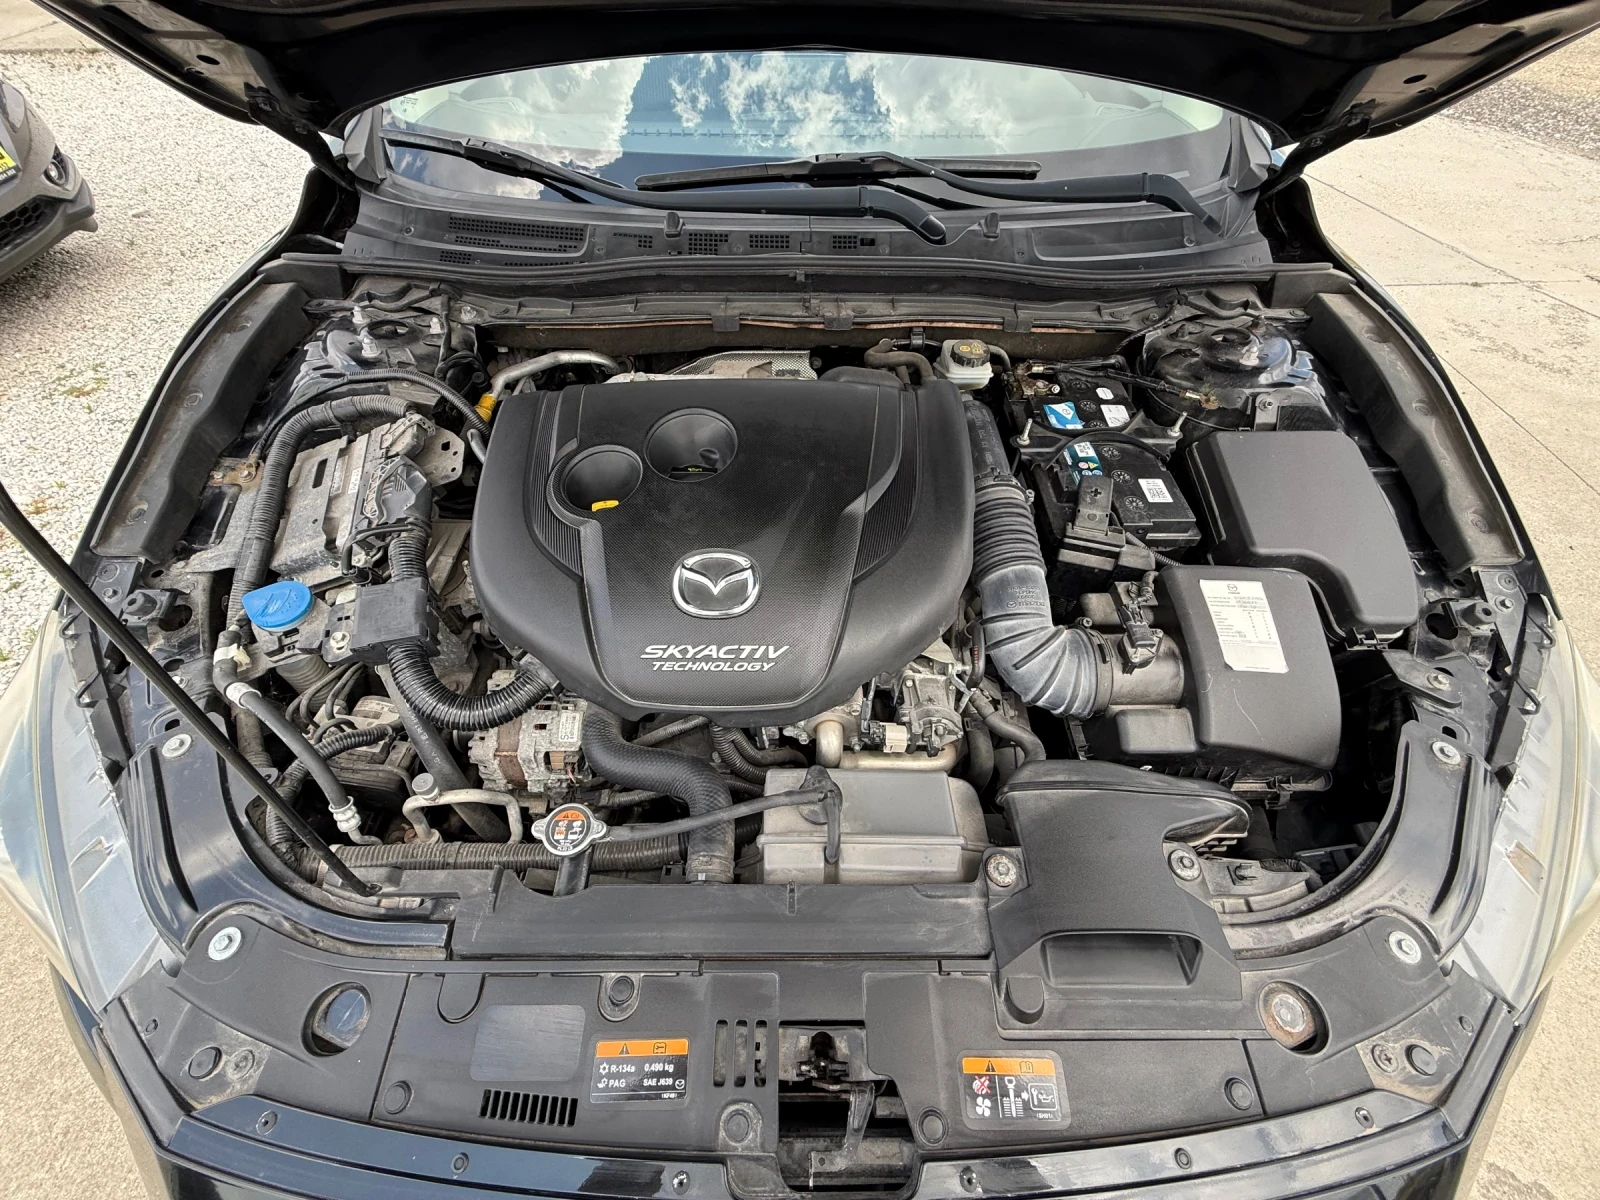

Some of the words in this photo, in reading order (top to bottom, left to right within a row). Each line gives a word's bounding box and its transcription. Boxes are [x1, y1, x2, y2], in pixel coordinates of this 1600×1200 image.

[640, 645, 790, 659] SKYACTIV
[652, 661, 776, 672] TECHNOLOGY
[610, 1064, 635, 1073] R-134a
[664, 1062, 674, 1073] kg
[608, 1078, 626, 1088] PAG
[643, 1078, 657, 1086] SAE
[658, 1077, 673, 1086] J639
